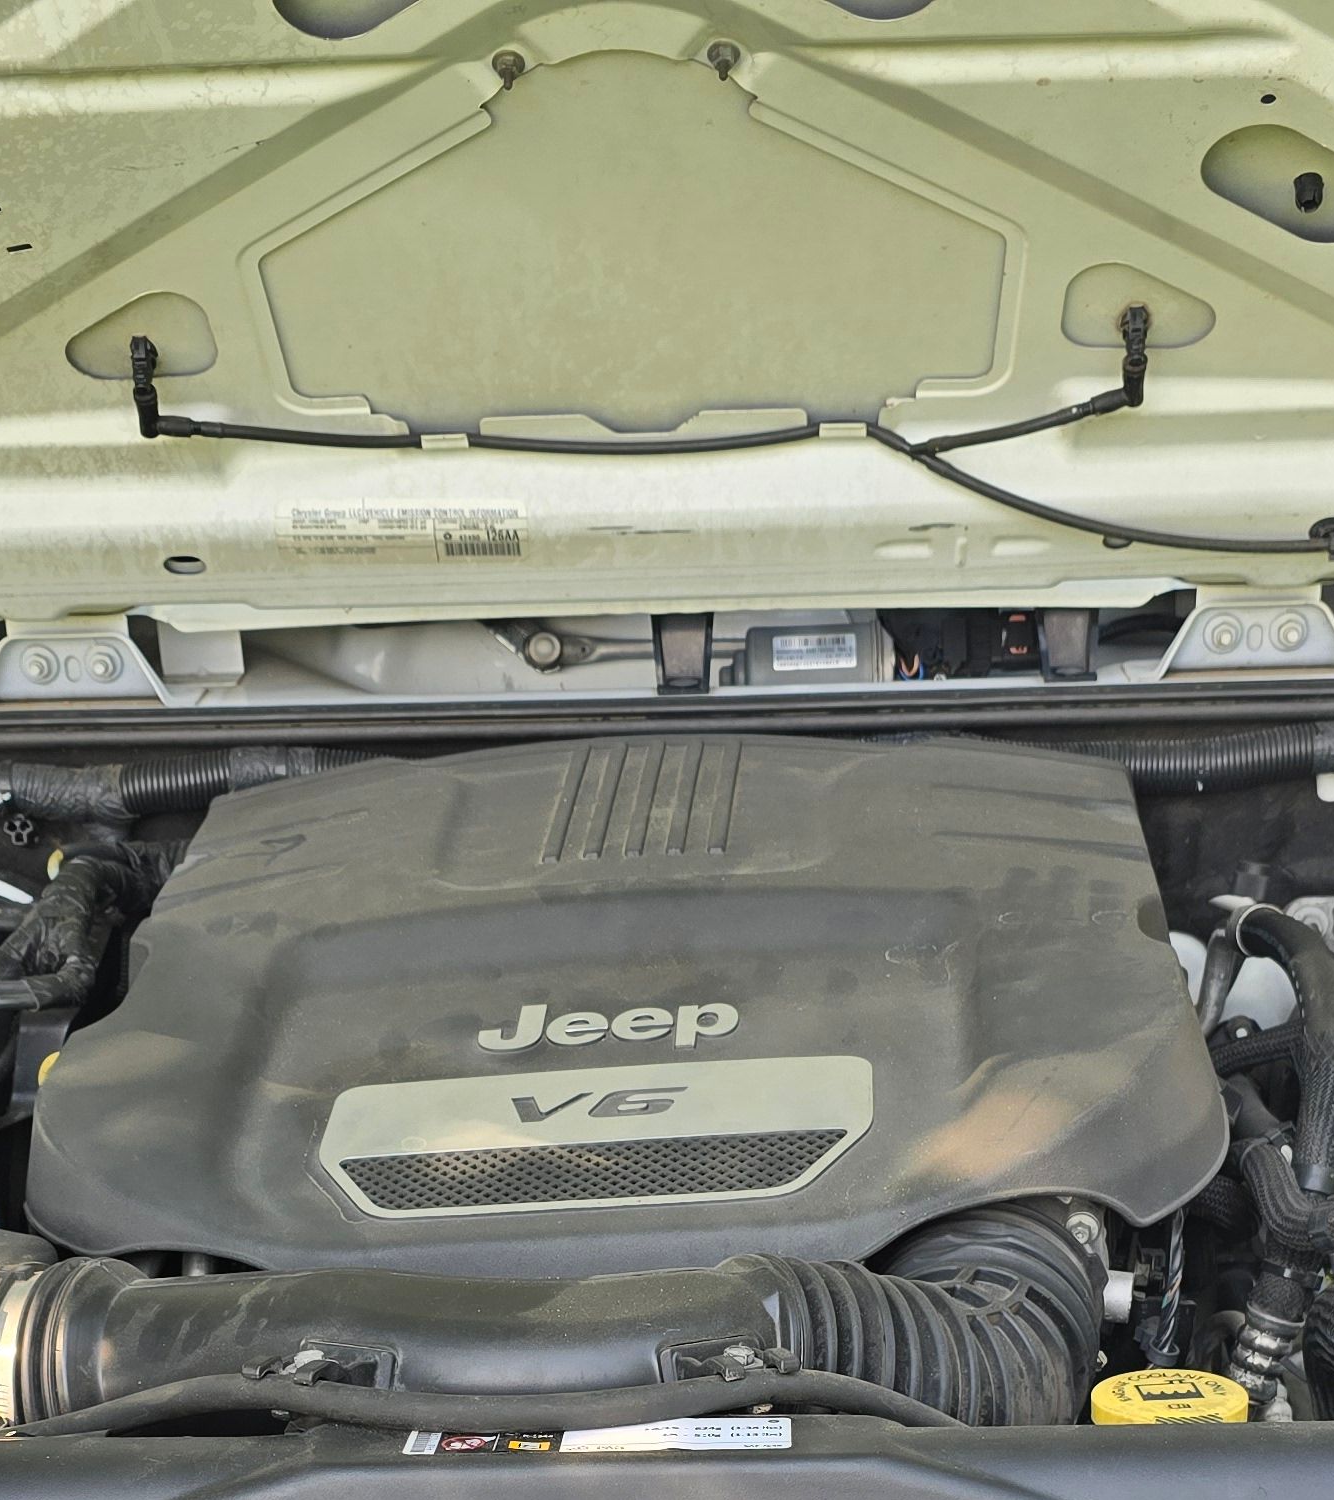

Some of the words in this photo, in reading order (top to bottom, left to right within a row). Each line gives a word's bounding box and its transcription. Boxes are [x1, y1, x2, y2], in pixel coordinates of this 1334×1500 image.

[477, 1003, 739, 1052] Jeep
[511, 1086, 689, 1123] V6
[1128, 1372, 1205, 1382] COOLANT
[1204, 1380, 1227, 1396] ONLY
